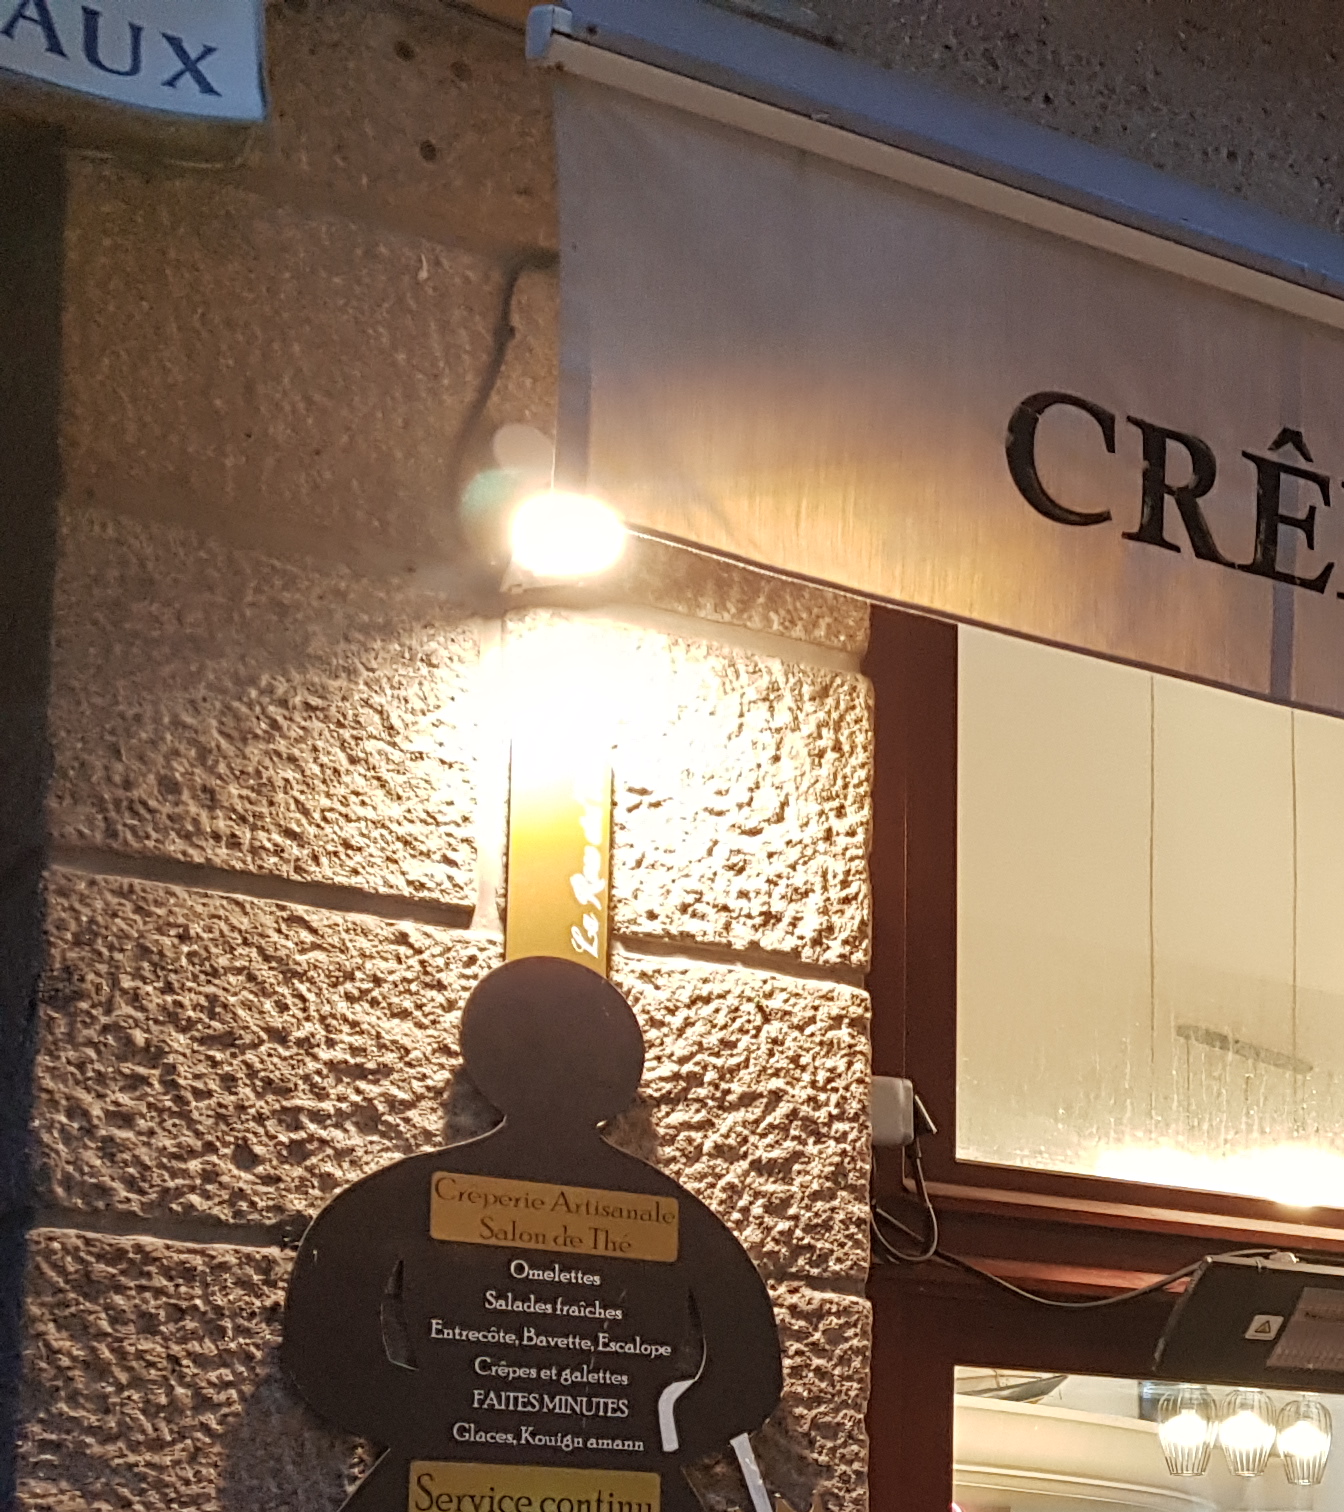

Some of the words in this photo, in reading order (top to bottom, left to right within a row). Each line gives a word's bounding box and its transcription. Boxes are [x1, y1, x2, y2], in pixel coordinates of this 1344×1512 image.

[0, 0, 222, 97] AUX
[434, 1176, 545, 1210] Crêperie
[550, 1190, 676, 1226] Artisanale
[479, 1216, 546, 1246] Salon
[553, 1226, 583, 1249] de
[589, 1226, 633, 1253] Thé
[510, 1259, 601, 1286] Omelettes
[485, 1290, 552, 1314] Salades
[556, 1297, 623, 1320] fraîches
[430, 1319, 519, 1347] Entrecôte,
[522, 1327, 595, 1352] Bavette,
[598, 1332, 672, 1359] Escalope
[474, 1356, 537, 1381] Crêpes
[540, 1366, 558, 1380] et
[560, 1364, 629, 1386] galettes
[472, 1389, 540, 1412] FAITES
[543, 1395, 629, 1418] MINUTES
[453, 1422, 517, 1446] Glaces,
[520, 1426, 583, 1451] Kouign
[587, 1437, 644, 1451] amann
